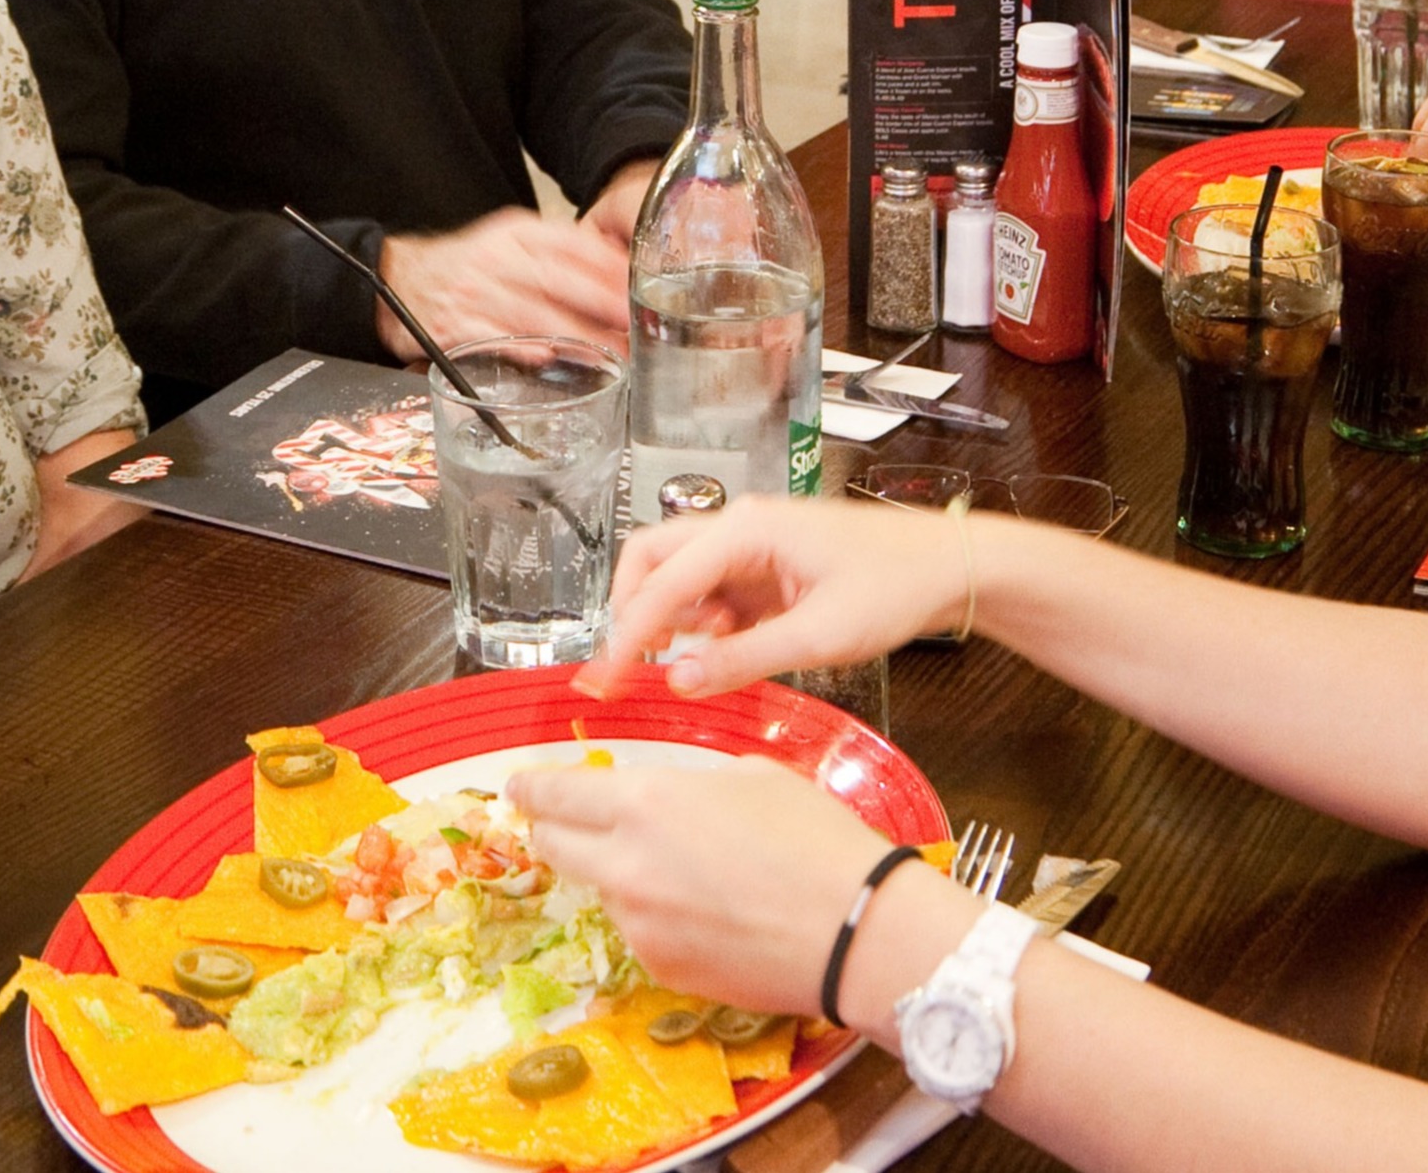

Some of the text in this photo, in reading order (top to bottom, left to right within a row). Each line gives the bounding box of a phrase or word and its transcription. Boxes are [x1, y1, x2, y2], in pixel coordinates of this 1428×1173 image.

[1000, 17, 1016, 41] MIX
[999, 44, 1015, 77] COOL
[999, 79, 1014, 89] A
